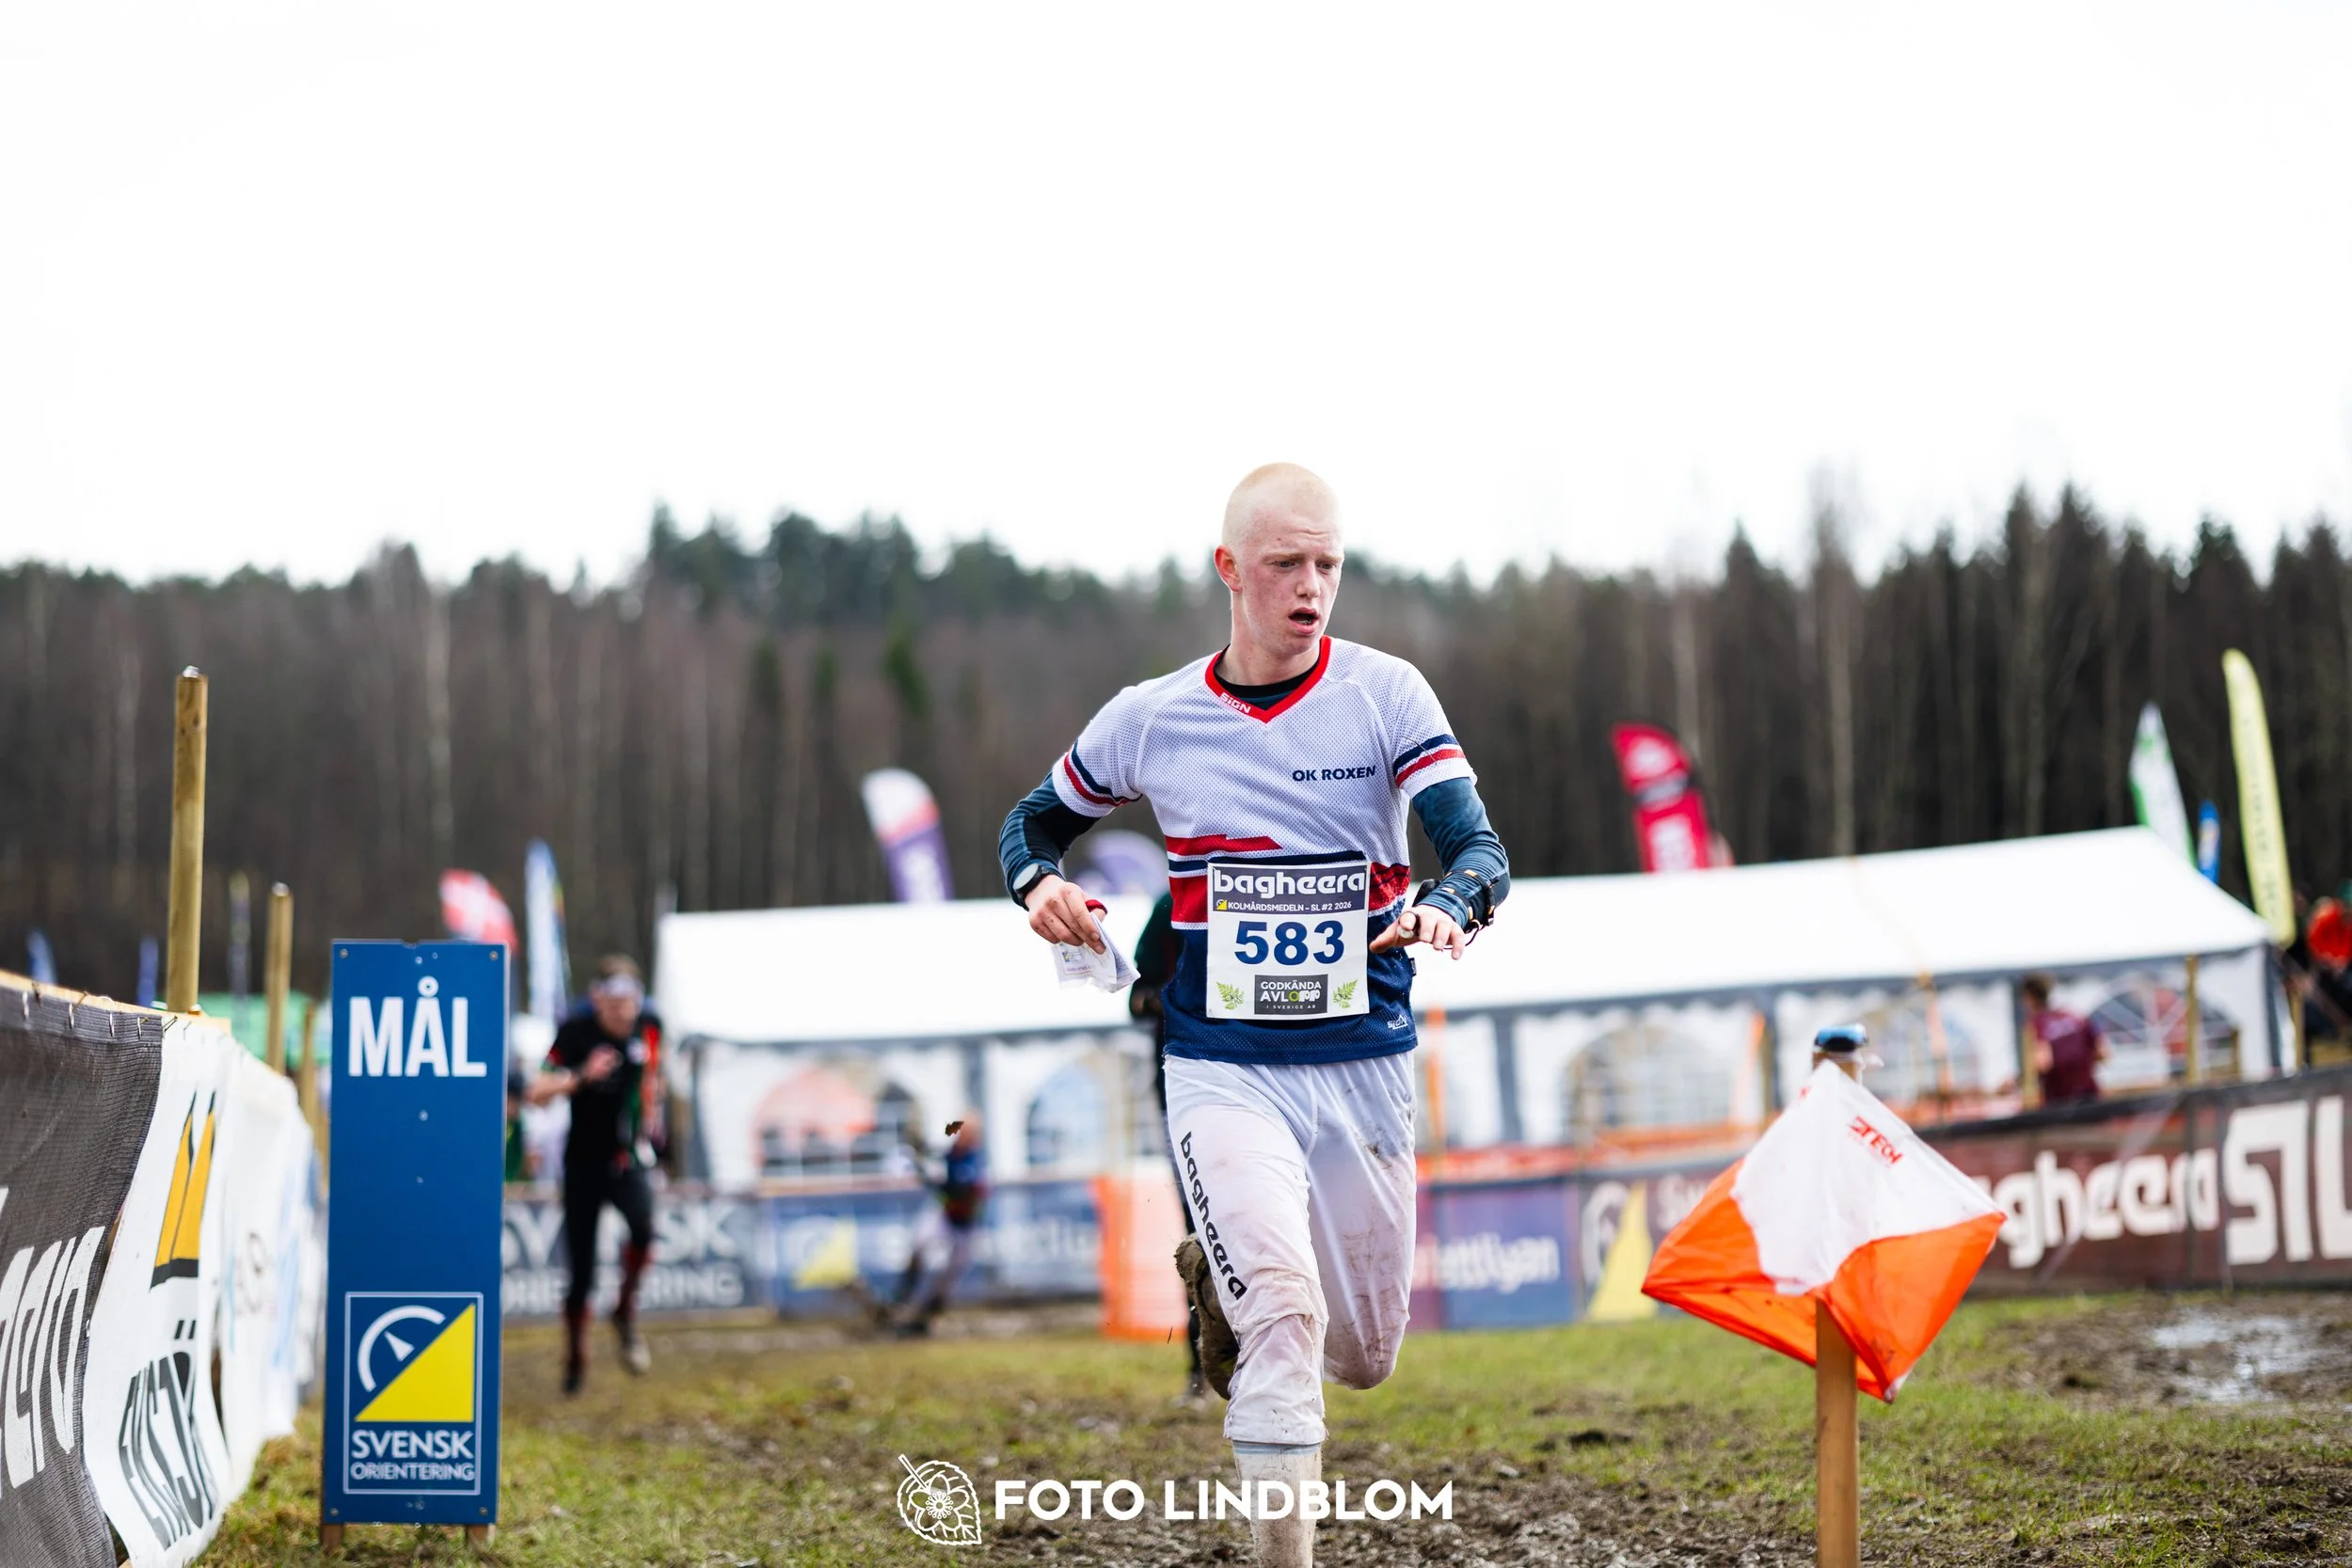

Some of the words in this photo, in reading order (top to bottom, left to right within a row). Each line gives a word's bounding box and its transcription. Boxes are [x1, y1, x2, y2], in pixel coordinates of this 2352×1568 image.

[1292, 769, 1317, 782] OK
[1321, 766, 1376, 781] ROXEN
[1214, 869, 1365, 899] bagheera
[1228, 900, 1304, 911] KOLMÅRDSMEDELN
[1311, 902, 1321, 911] SL
[1321, 902, 1333, 911] #2
[1334, 900, 1352, 910] 2026
[1234, 920, 1345, 966] 583
[1260, 990, 1321, 1002] AVLOPP
[1261, 979, 1322, 990] GODKÄNDA
[348, 974, 487, 1077] MÅL
[1180, 1131, 1248, 1301] bagheera
[351, 1429, 474, 1459] SVENSK
[350, 1461, 475, 1481] ORIENTERING
